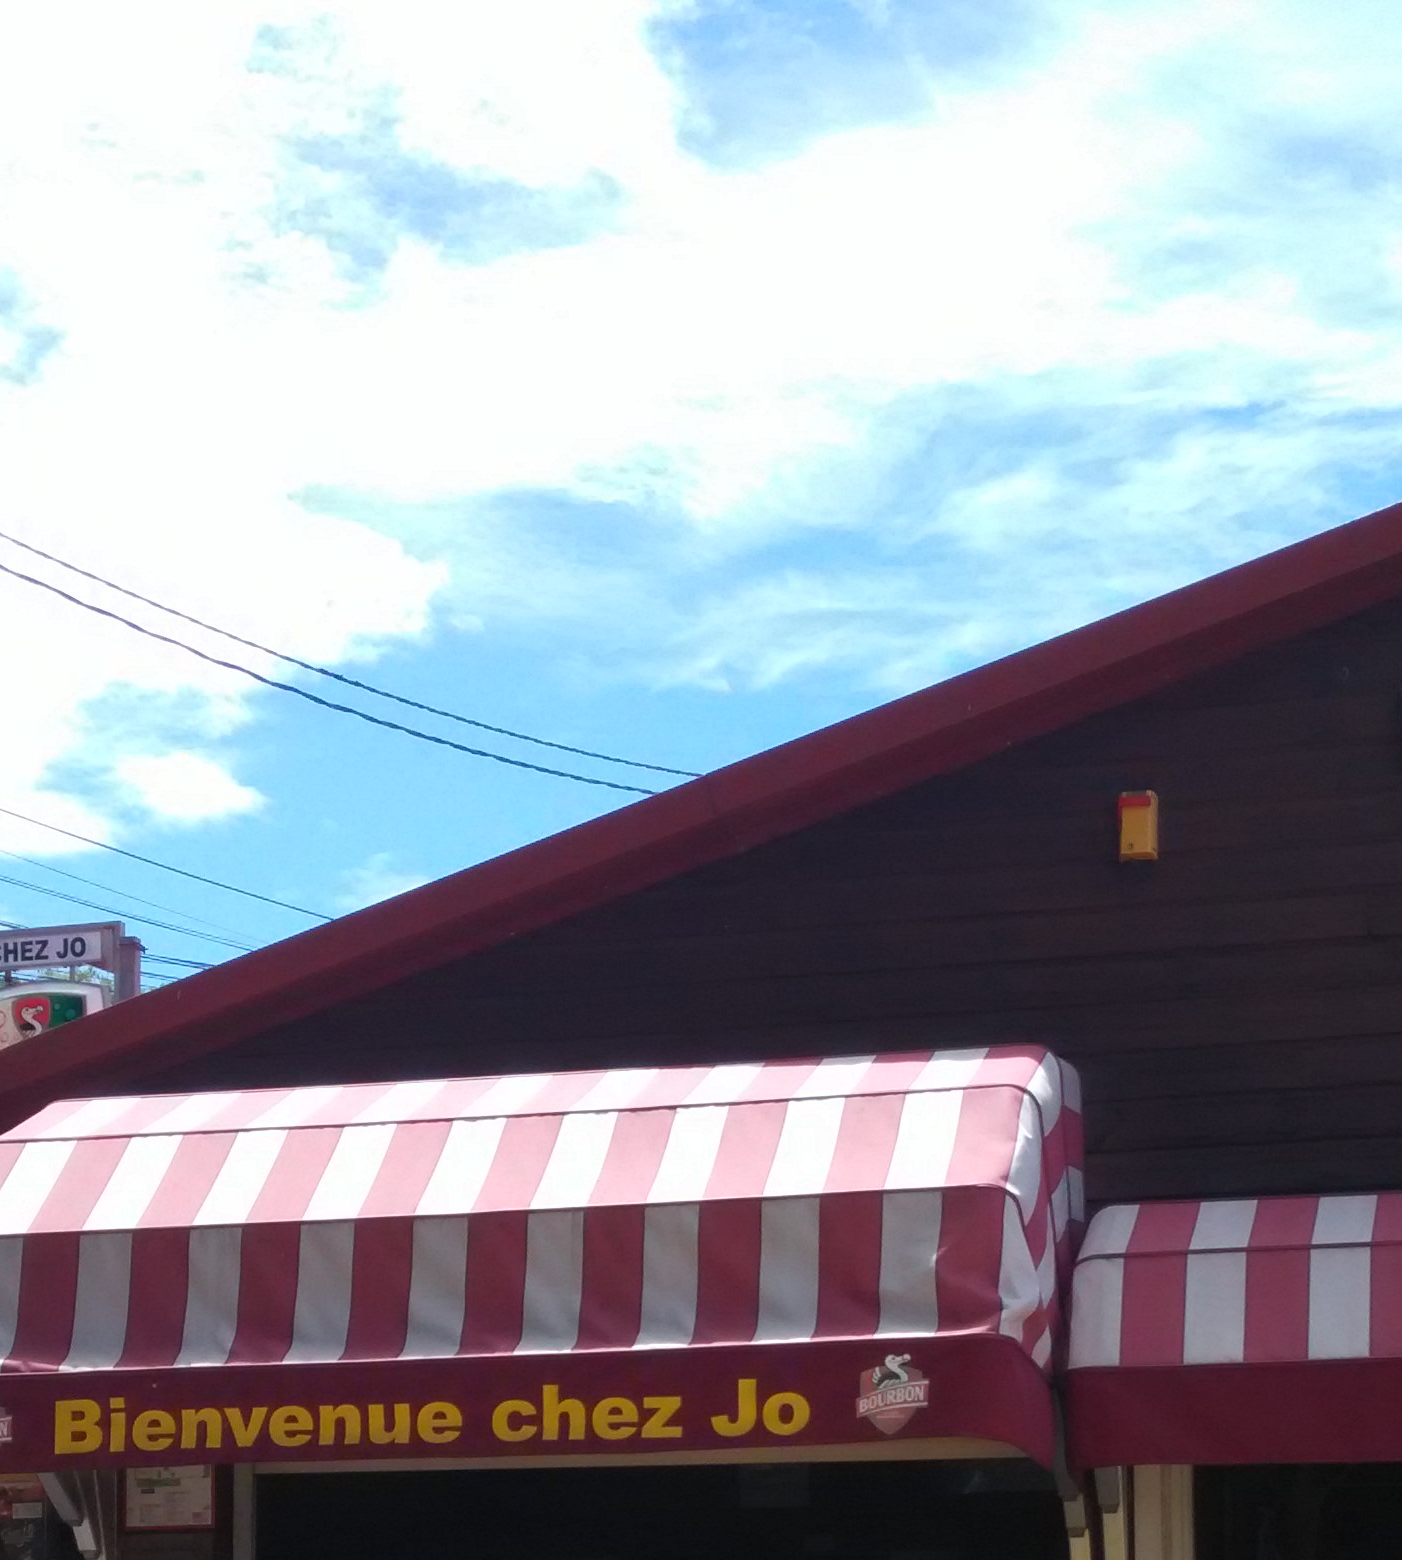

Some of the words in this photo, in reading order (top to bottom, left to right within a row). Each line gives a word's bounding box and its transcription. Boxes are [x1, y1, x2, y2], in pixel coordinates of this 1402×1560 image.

[56, 936, 86, 959] JO
[859, 1385, 924, 1413] BOURBON
[54, 1397, 463, 1455] Bienvenue
[492, 1384, 684, 1441] chez
[710, 1377, 811, 1437] Jo
